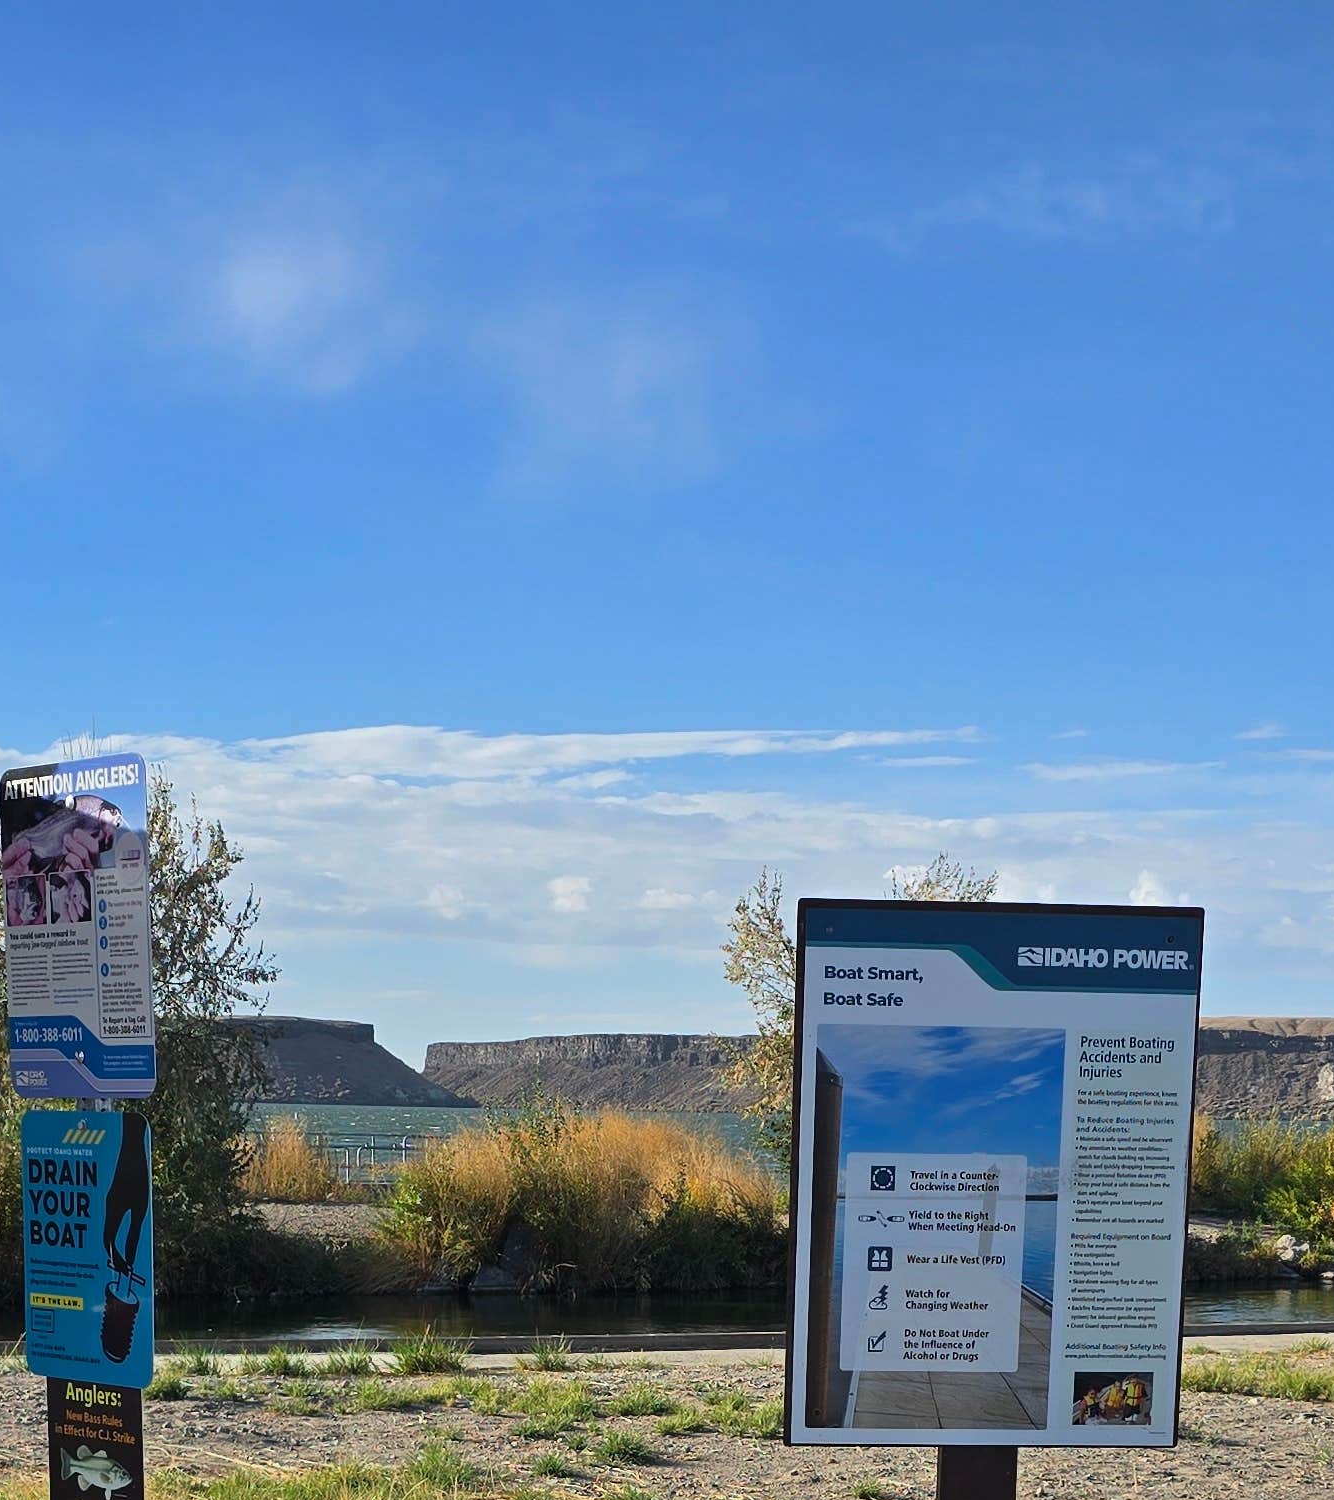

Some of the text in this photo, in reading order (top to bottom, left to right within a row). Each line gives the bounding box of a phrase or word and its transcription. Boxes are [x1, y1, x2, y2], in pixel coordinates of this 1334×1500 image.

[5, 764, 139, 800] ATTENTION ANGLERS!
[1045, 948, 1188, 970] IDAHO POWER
[825, 966, 923, 983] Boat Smart,
[824, 992, 903, 1007] Boat Safe
[15, 1027, 82, 1042] 1-800-388-6011
[1081, 1036, 1174, 1052] Prevent Boating
[1080, 1051, 1161, 1063] Accidents and
[1079, 1066, 1122, 1080] Injuries
[28, 1159, 97, 1187] DRAIN
[910, 1171, 938, 1179] Travel
[960, 1172, 998, 1180] Counter-
[910, 1183, 999, 1191] Clockwise Direction
[29, 1190, 91, 1218] YOUR
[909, 1211, 932, 1219] Yield
[947, 1211, 962, 1219] the
[965, 1212, 988, 1222] Right
[30, 1220, 87, 1248] BOAT
[937, 1223, 974, 1233] Meeting
[977, 1223, 1015, 1232] Head-On
[907, 1255, 930, 1263] Wear
[941, 1256, 958, 1264] Life
[960, 1256, 979, 1264] Vest
[981, 1256, 1005, 1266] (PFD)
[49, 1297, 60, 1305] THE
[906, 1290, 950, 1298] Watch for
[906, 1301, 988, 1311] Changing Weather
[905, 1329, 916, 1337] Do
[920, 1329, 936, 1337] Not
[963, 1329, 989, 1338] Under
[904, 1340, 975, 1349] the Influence of
[903, 1352, 937, 1360] Alcohol
[953, 1352, 978, 1362] Drugs
[66, 1382, 121, 1407] Anglers:
[67, 1409, 123, 1427] New Bass Rules
[64, 1424, 85, 1437] Effect
[86, 1426, 97, 1438] for
[113, 1431, 135, 1445] Strike
